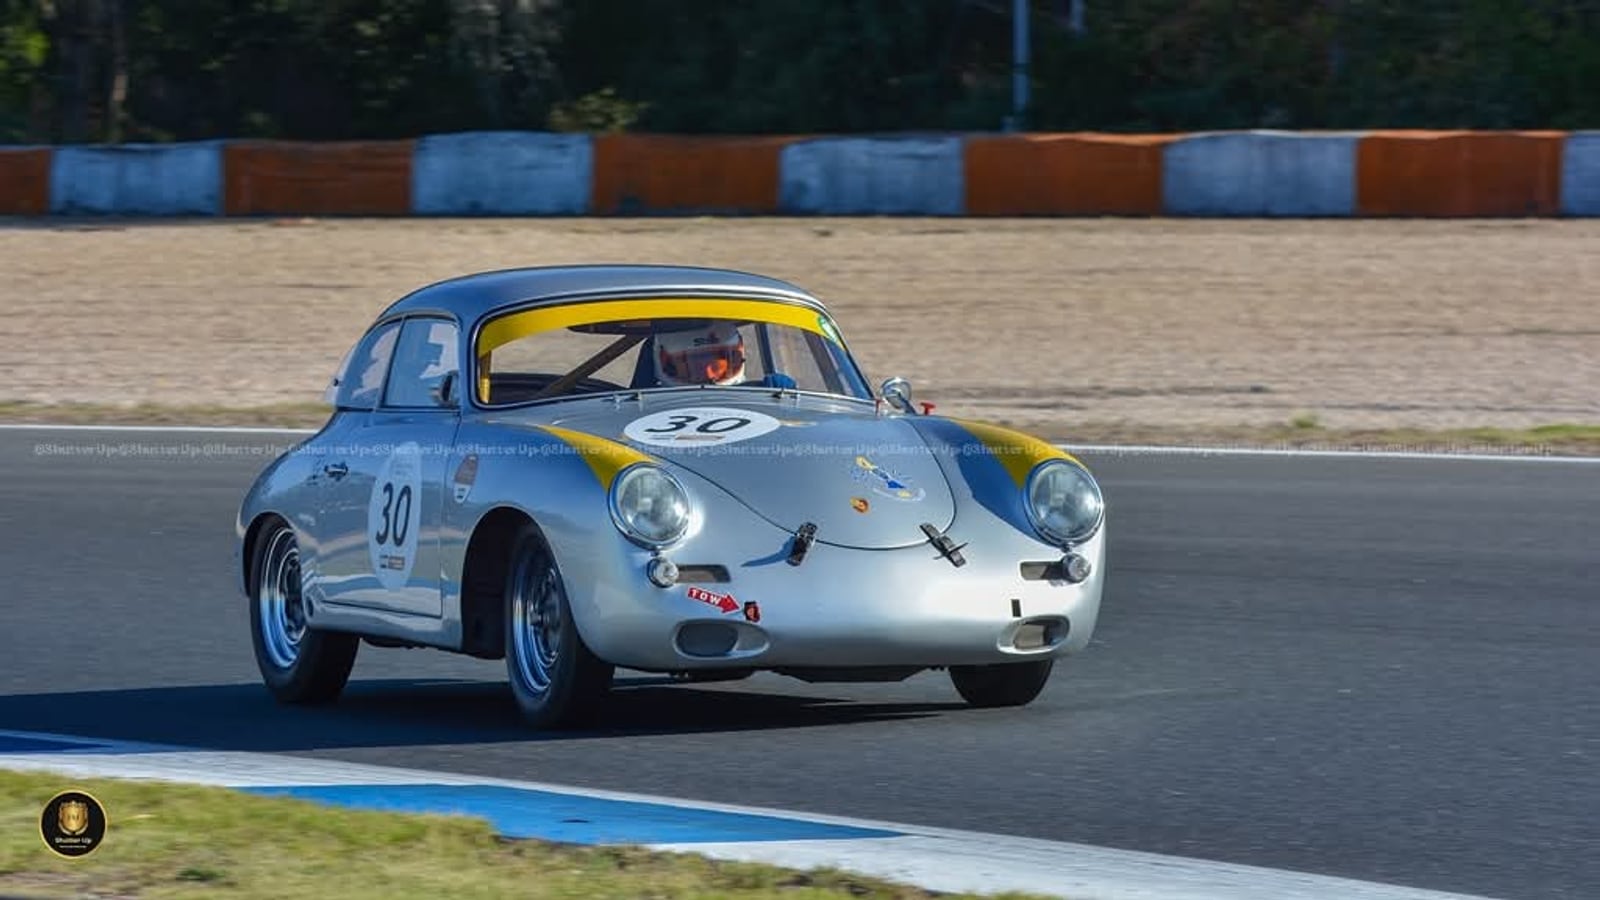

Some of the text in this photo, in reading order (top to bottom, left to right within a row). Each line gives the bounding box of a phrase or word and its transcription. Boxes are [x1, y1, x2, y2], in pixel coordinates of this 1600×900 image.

[644, 415, 752, 433] 30
[376, 482, 411, 547] 30
[691, 588, 721, 605] TOW
